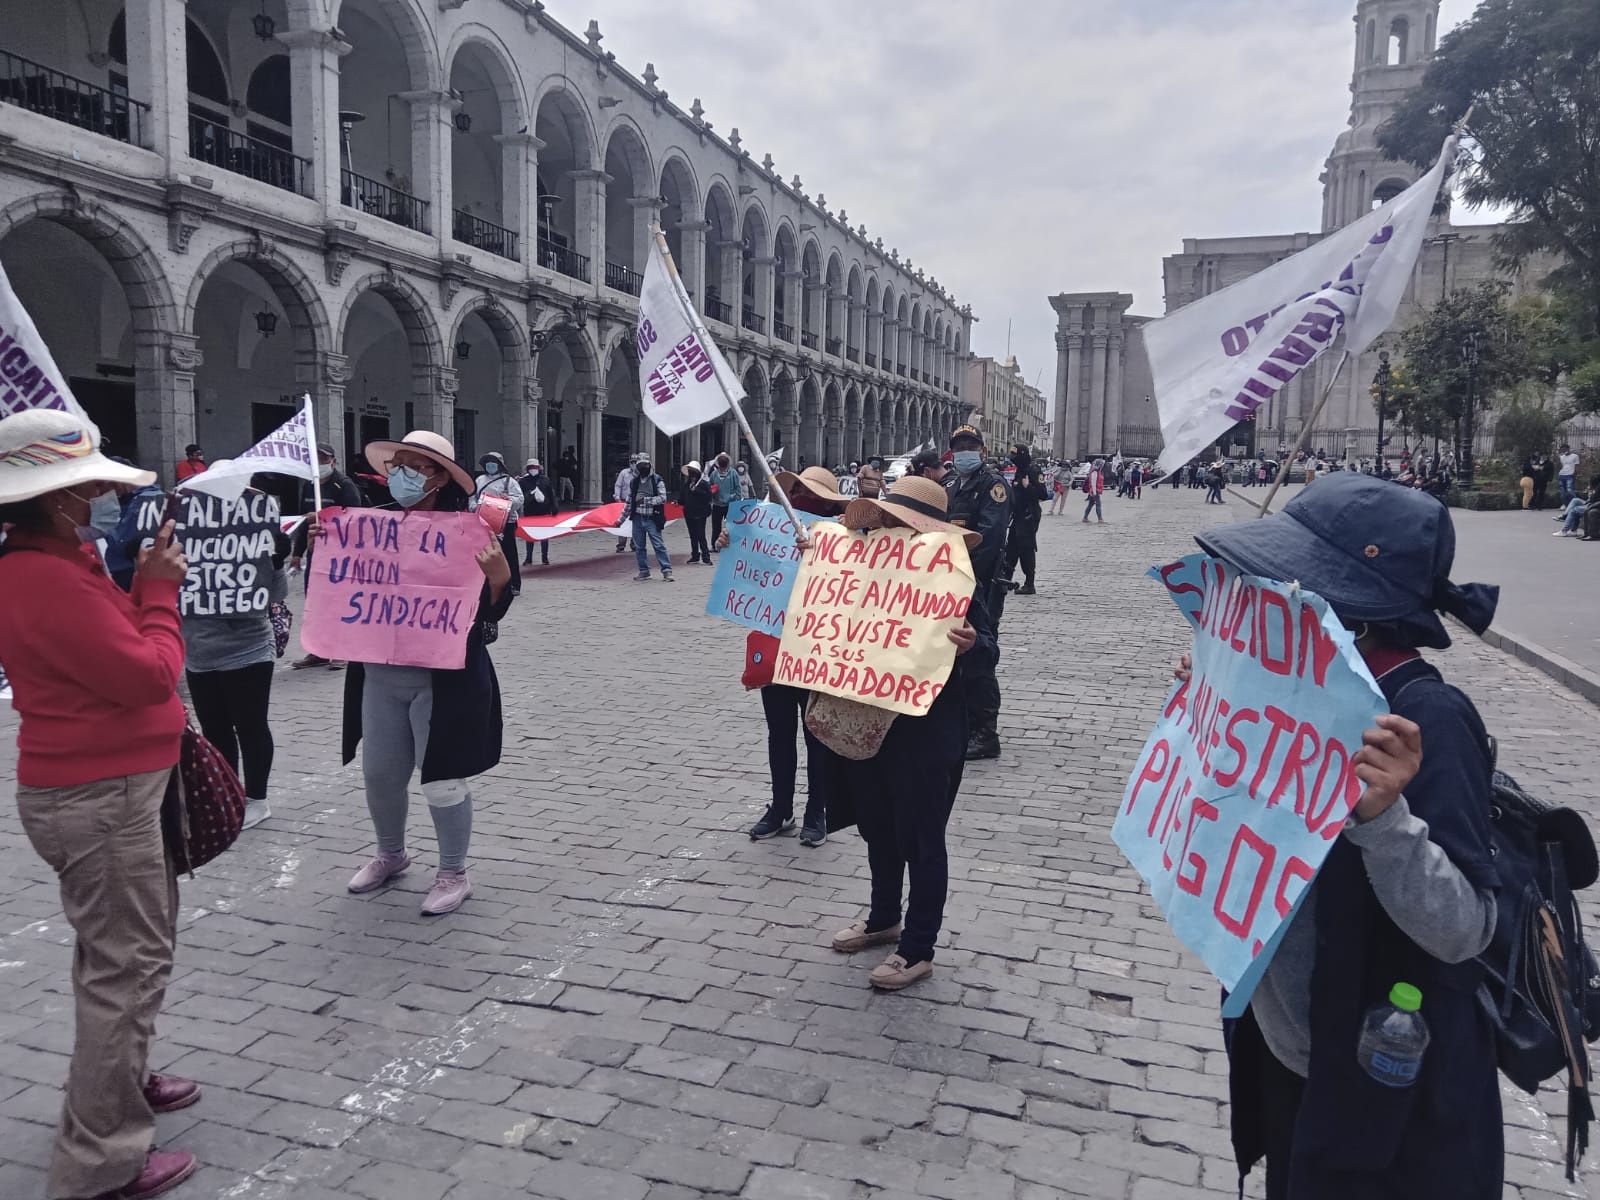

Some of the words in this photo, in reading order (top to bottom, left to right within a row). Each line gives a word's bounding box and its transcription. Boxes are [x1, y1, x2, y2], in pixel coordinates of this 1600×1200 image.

[419, 524, 447, 557] LA
[808, 531, 954, 573] INCALPACA
[329, 554, 400, 585] UNION
[734, 559, 783, 588] PLIEGO
[181, 586, 269, 616] PLIEGO
[802, 570, 861, 608] VISTE
[810, 643, 822, 656] A
[829, 645, 865, 663] SUS
